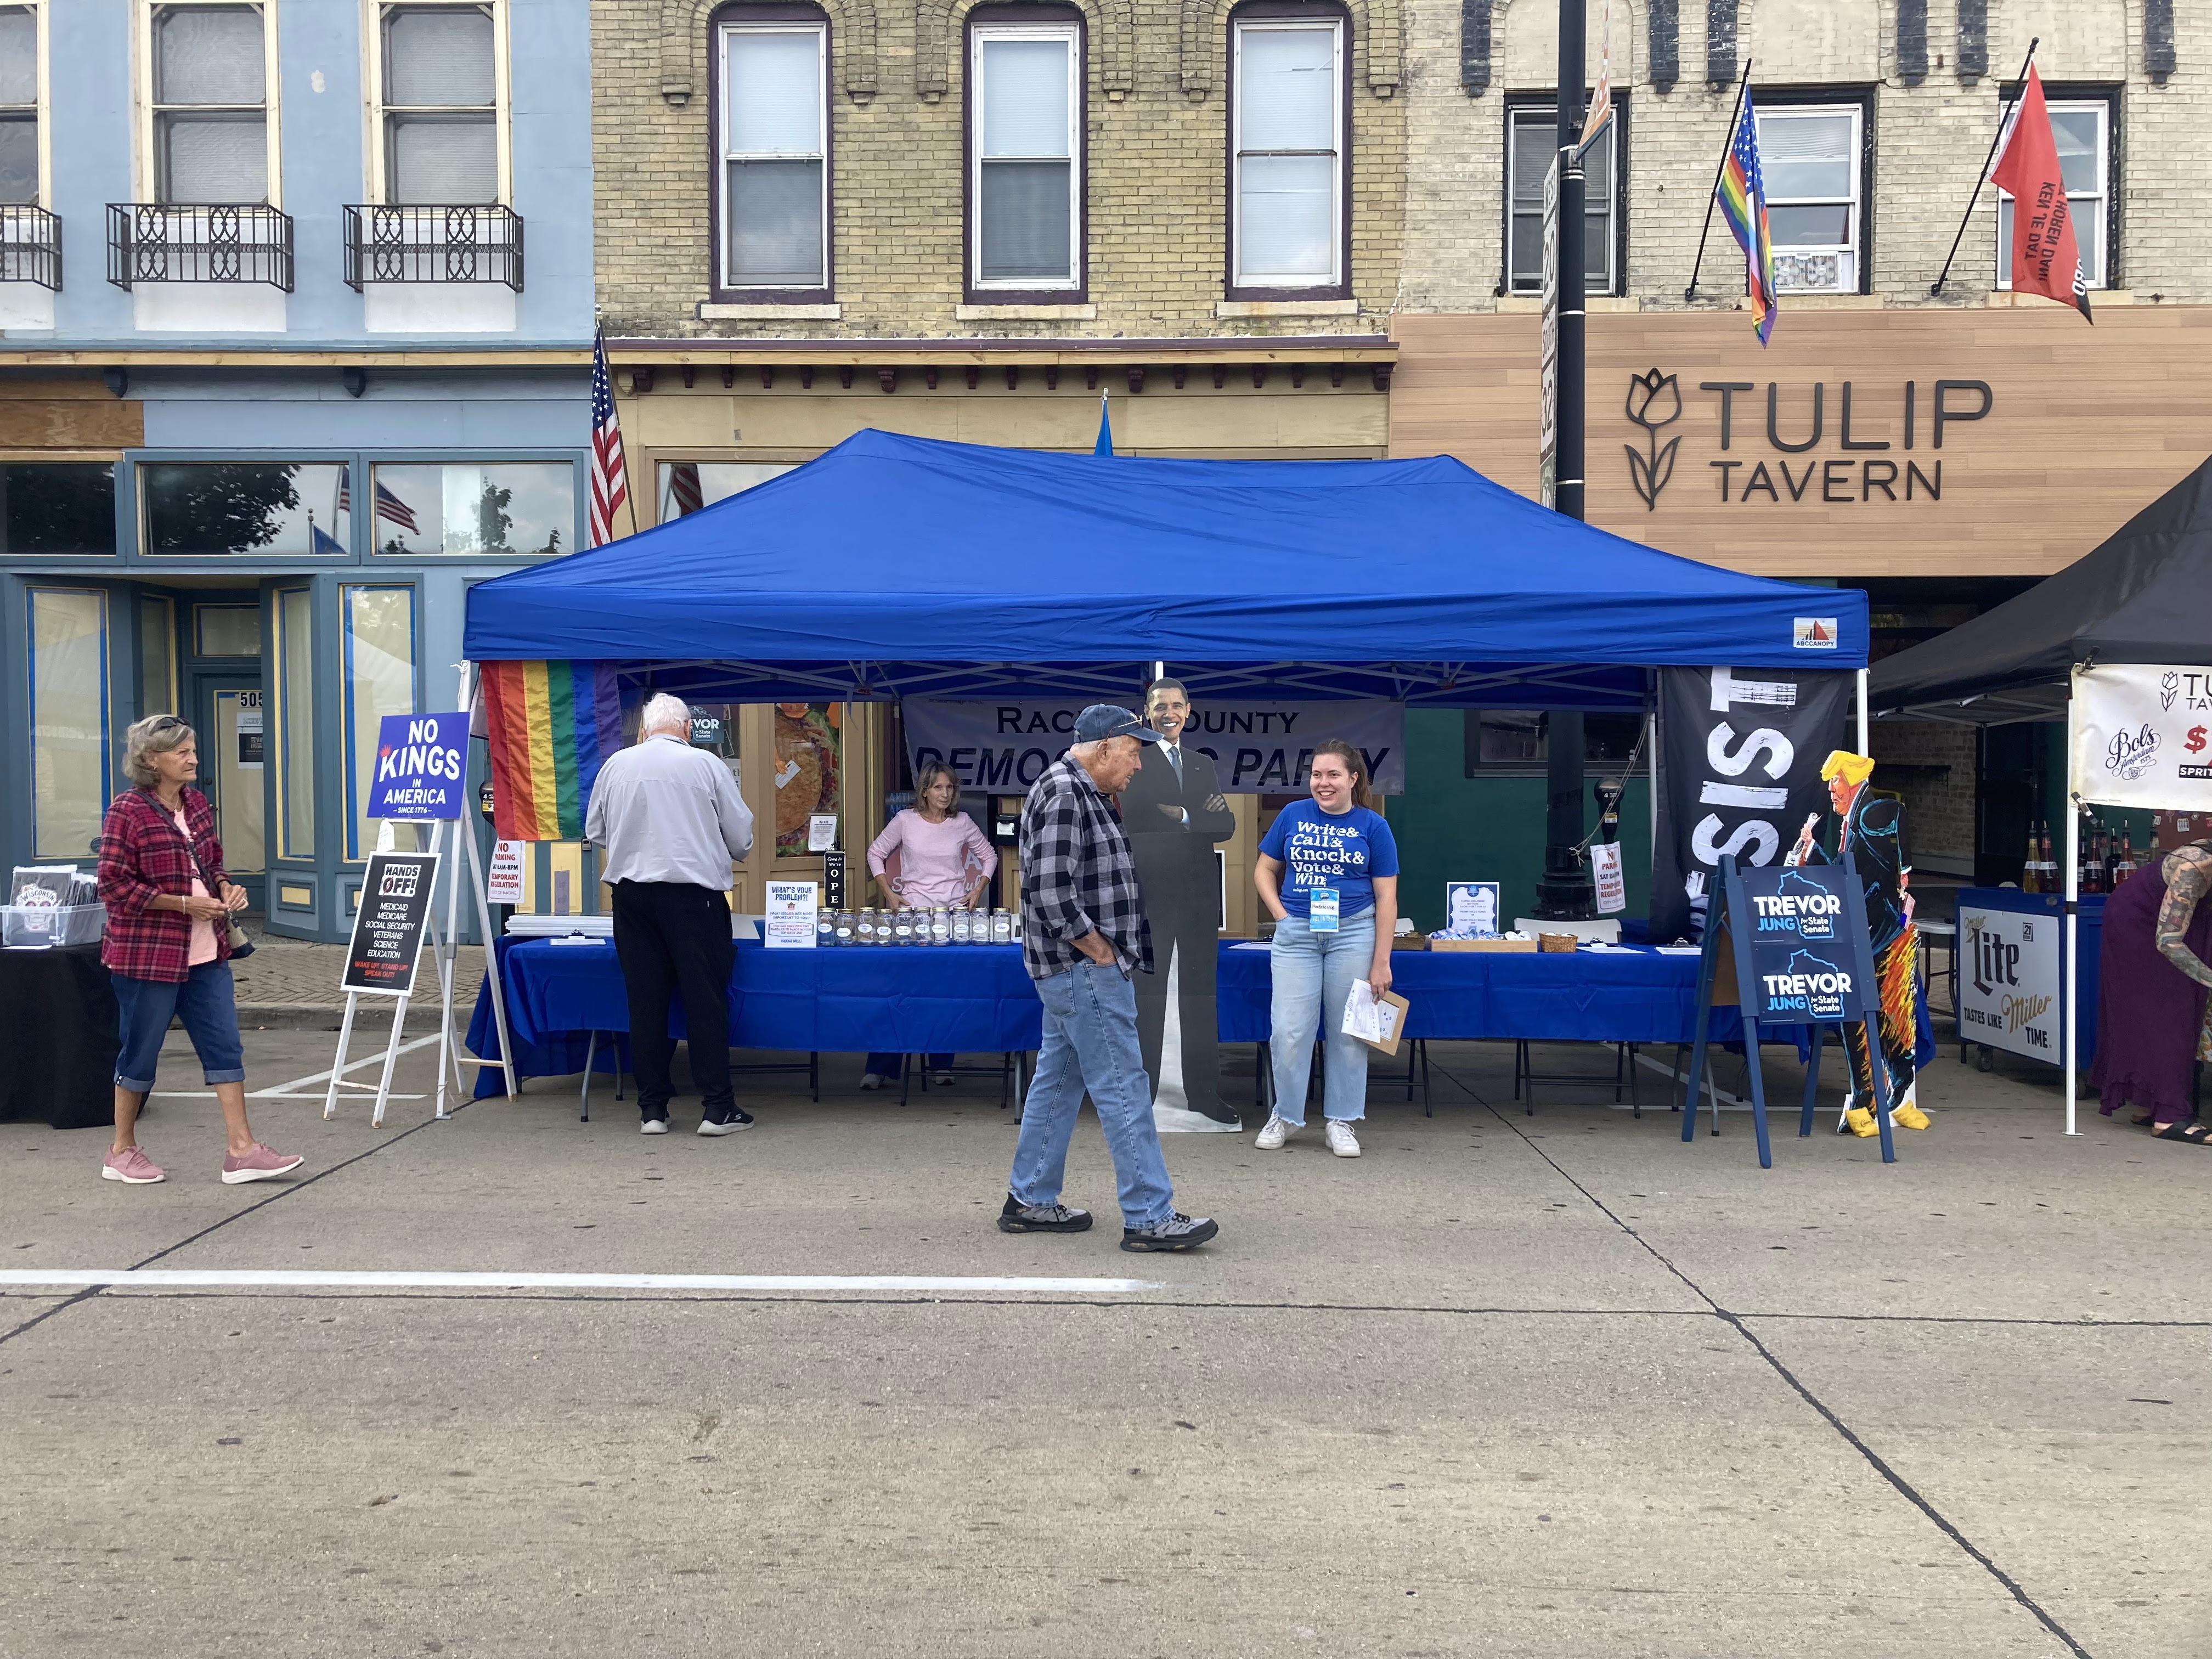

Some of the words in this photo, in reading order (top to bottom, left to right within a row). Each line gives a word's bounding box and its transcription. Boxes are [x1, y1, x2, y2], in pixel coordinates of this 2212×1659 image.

[1545, 168, 1556, 212] WEST
[1544, 230, 1554, 295] 20
[1542, 379, 1553, 437] 32
[1700, 379, 1993, 453] TULIP
[1709, 460, 1942, 502] TAVERN
[1181, 712, 1301, 733] OUNTY
[408, 719, 438, 744] NO
[2106, 723, 2156, 769] Bols
[379, 745, 460, 783] KINGS
[2119, 746, 2154, 771] Amsterdam
[412, 778, 421, 788] IN
[383, 788, 446, 804] AMERICA
[498, 843, 509, 852] NO
[386, 866, 418, 877] HANDS
[383, 877, 416, 894] OFF!
[20, 890, 55, 901] WISCONSIN
[380, 902, 408, 911] MEDICAID
[1753, 895, 1841, 916] TREVOR
[377, 911, 407, 921] MEDICARE
[1757, 917, 1796, 931] JUNG
[1808, 916, 1829, 926] State
[365, 921, 386, 929] SOCIAL
[386, 922, 415, 931] SECURITY
[1803, 925, 1830, 933] Senate
[1964, 916, 1986, 943] Miller
[2024, 924, 2032, 935] 21
[374, 930, 403, 940] VETERANS
[373, 940, 398, 949] SCIENCE
[367, 949, 400, 959] EDUCATION
[1973, 928, 2020, 996] Lite
[364, 969, 381, 978] SPEAK
[1763, 973, 1852, 995] TREVOR
[1767, 996, 1805, 1011] JUNG
[1818, 995, 1839, 1004] State
[1813, 1003, 1840, 1013] Senate
[2001, 994, 2052, 1034] Miller
[1963, 1007, 1985, 1025] TASTES
[1987, 1012, 2002, 1030] LIKE
[2025, 1026, 2048, 1048] TIME
